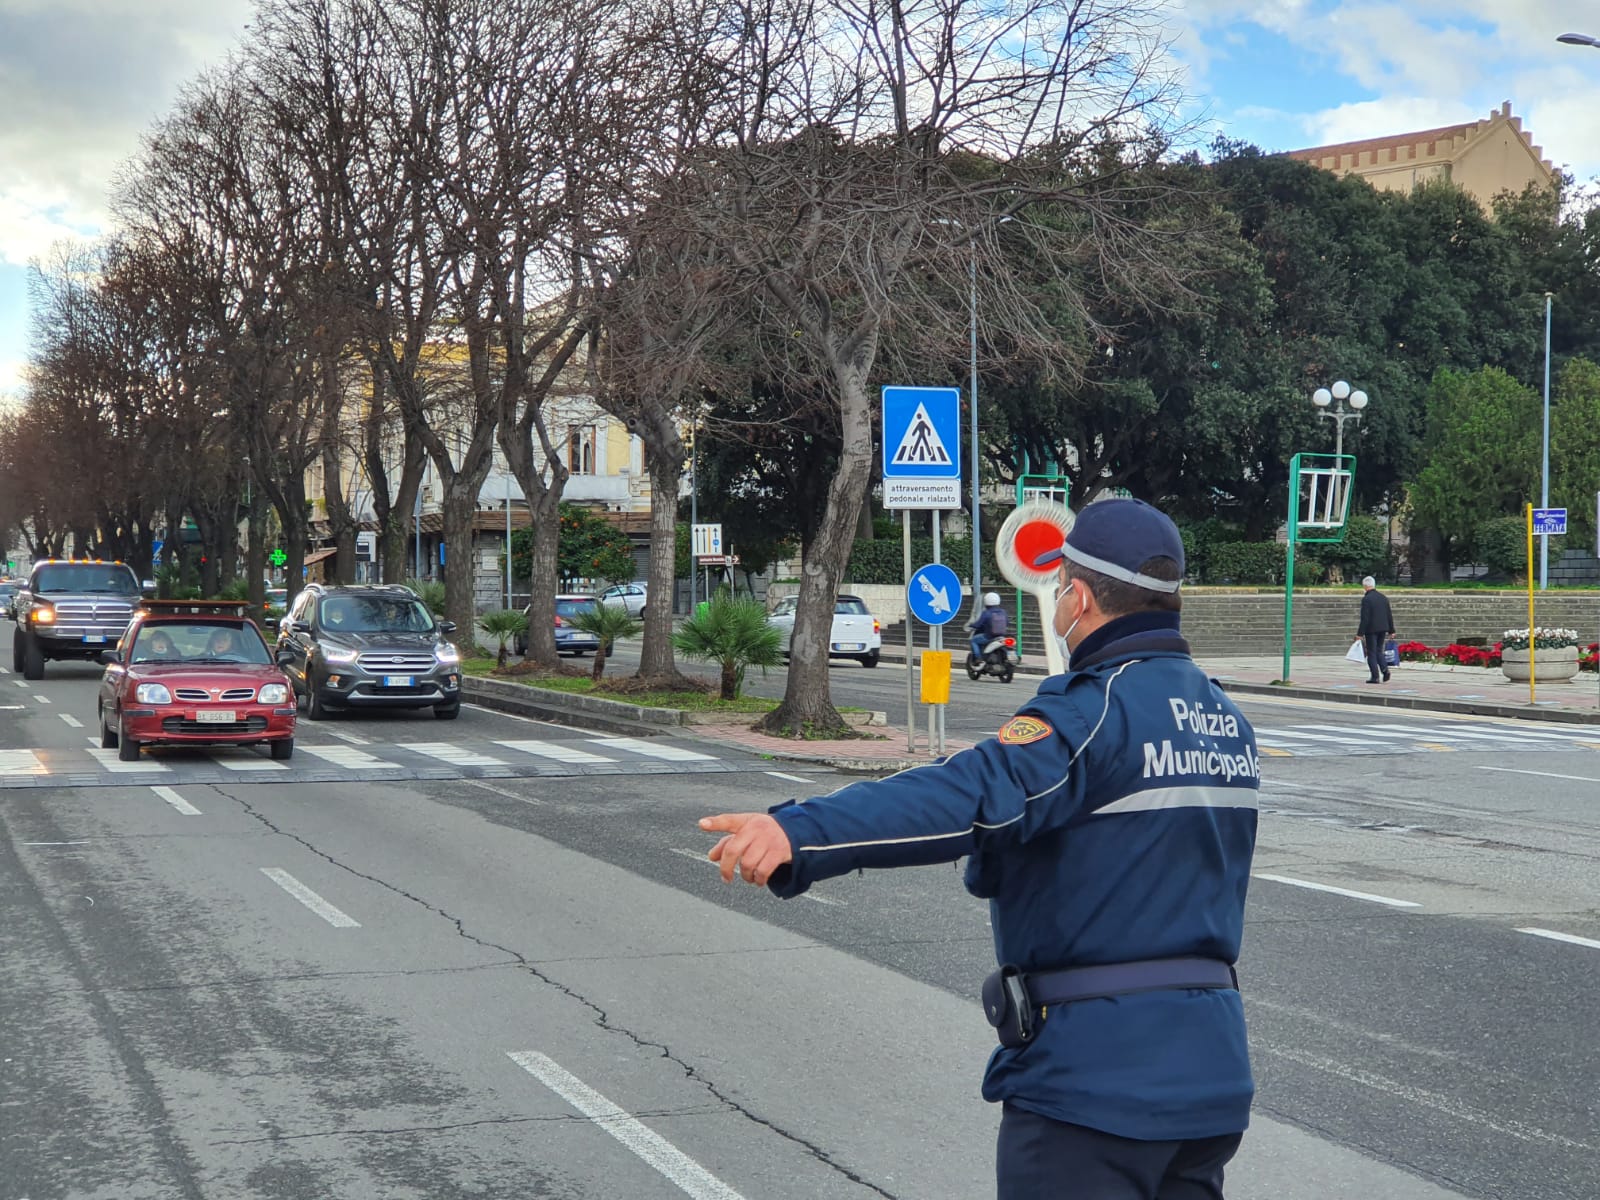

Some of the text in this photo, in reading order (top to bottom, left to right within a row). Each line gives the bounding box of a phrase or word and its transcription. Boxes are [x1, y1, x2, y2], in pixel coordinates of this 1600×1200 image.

[891, 484, 953, 492] attraversamento
[889, 494, 956, 504] pedonale rialzato
[1534, 524, 1565, 533] FERMATA
[1169, 698, 1239, 738] Polizia
